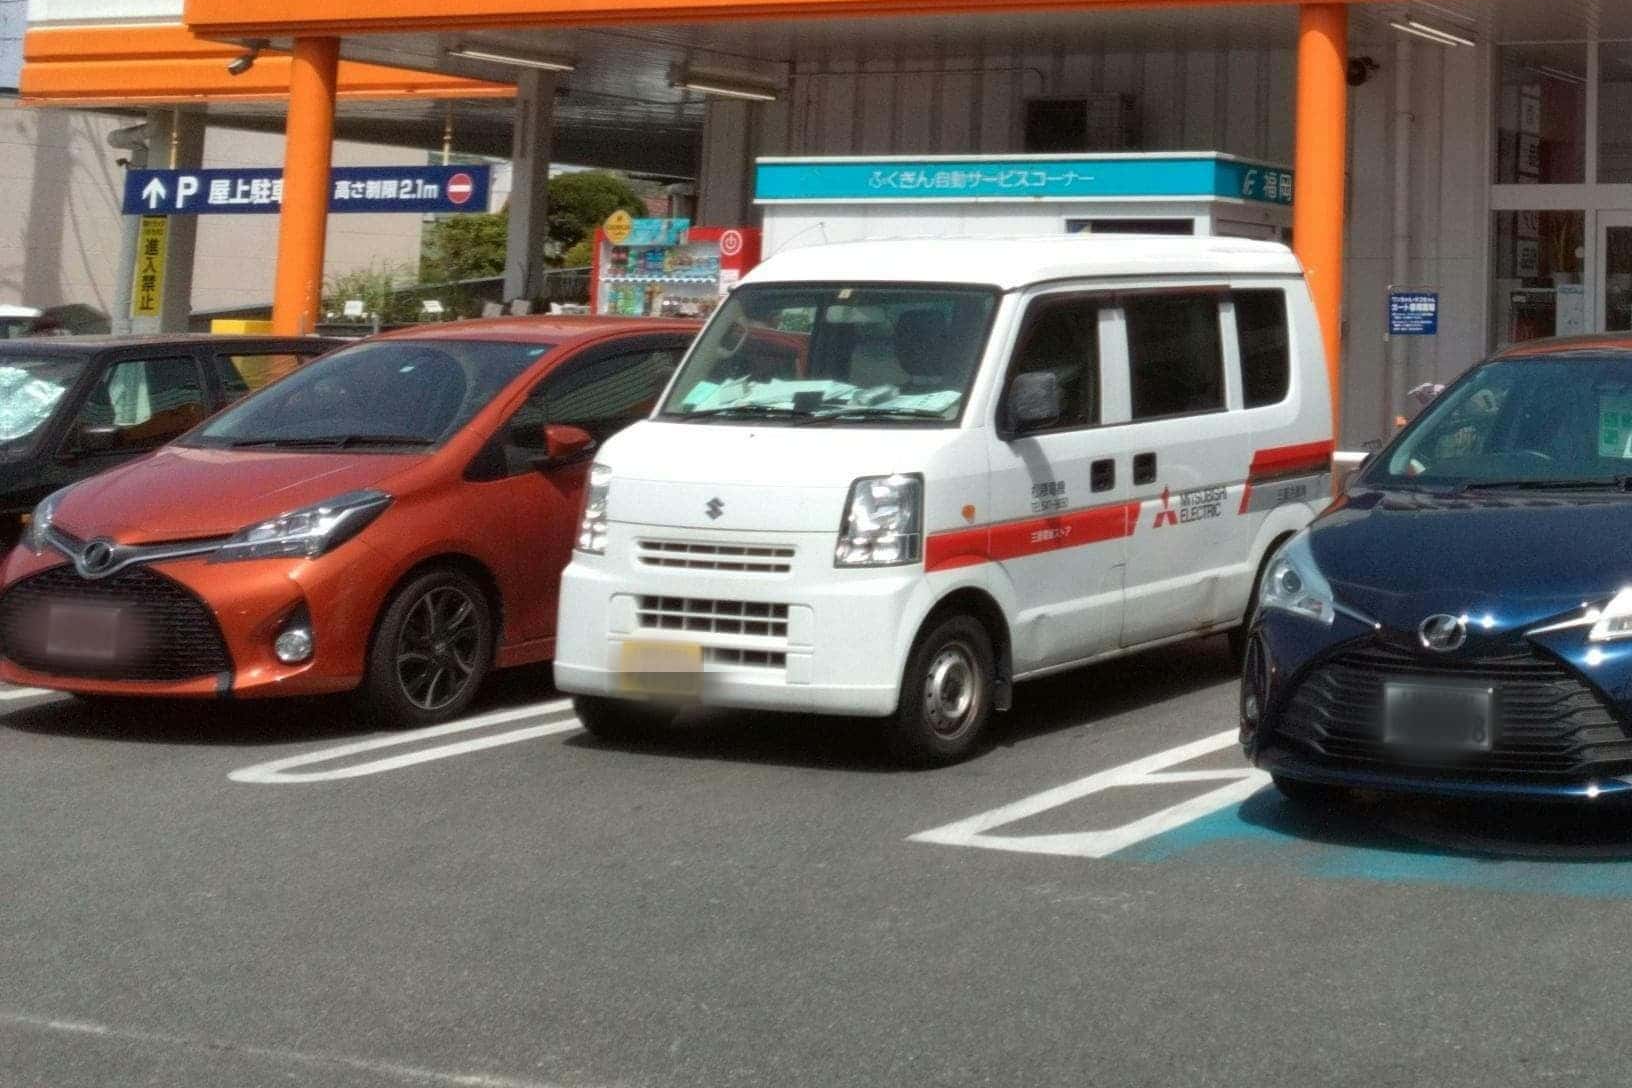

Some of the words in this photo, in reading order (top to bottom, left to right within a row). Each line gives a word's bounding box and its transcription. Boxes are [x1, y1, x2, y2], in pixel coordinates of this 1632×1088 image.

[868, 170, 1095, 190] ふくぎん自動サービスコーナー
[1180, 503, 1222, 523] ELECTRIC
